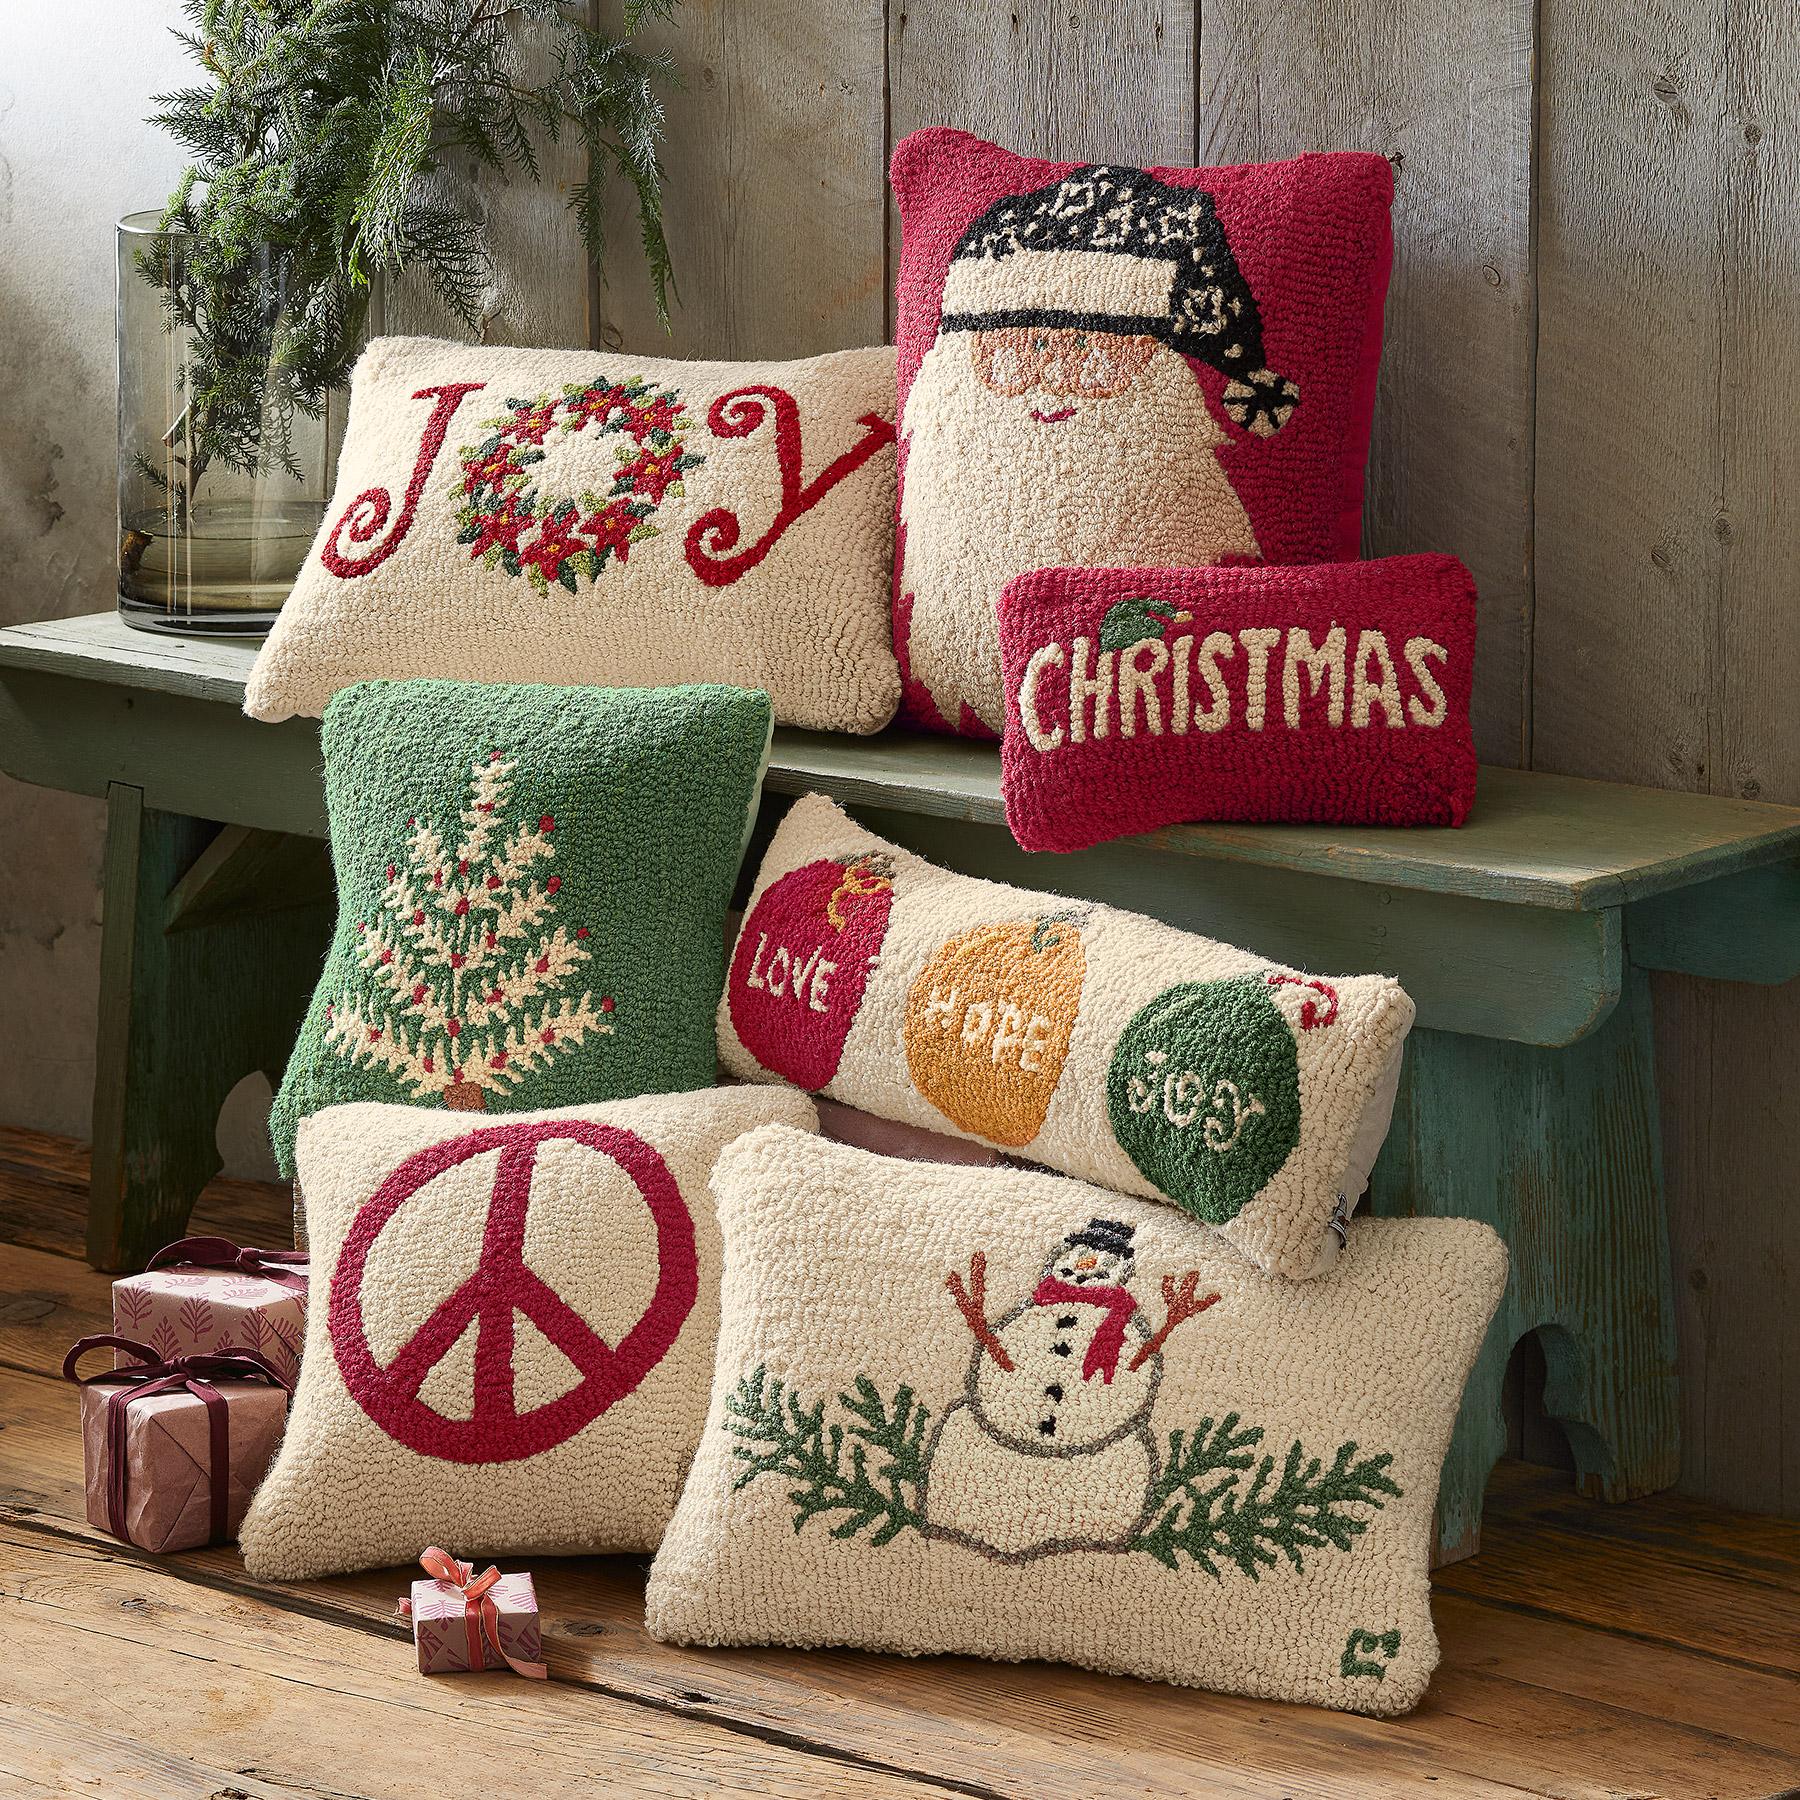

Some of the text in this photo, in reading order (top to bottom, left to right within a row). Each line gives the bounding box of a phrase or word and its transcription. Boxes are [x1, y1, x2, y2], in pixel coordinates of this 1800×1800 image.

[1018, 626, 1448, 752] CHRISTMAS
[748, 931, 838, 1013] LOVE
[925, 985, 1051, 1072] HOPE
